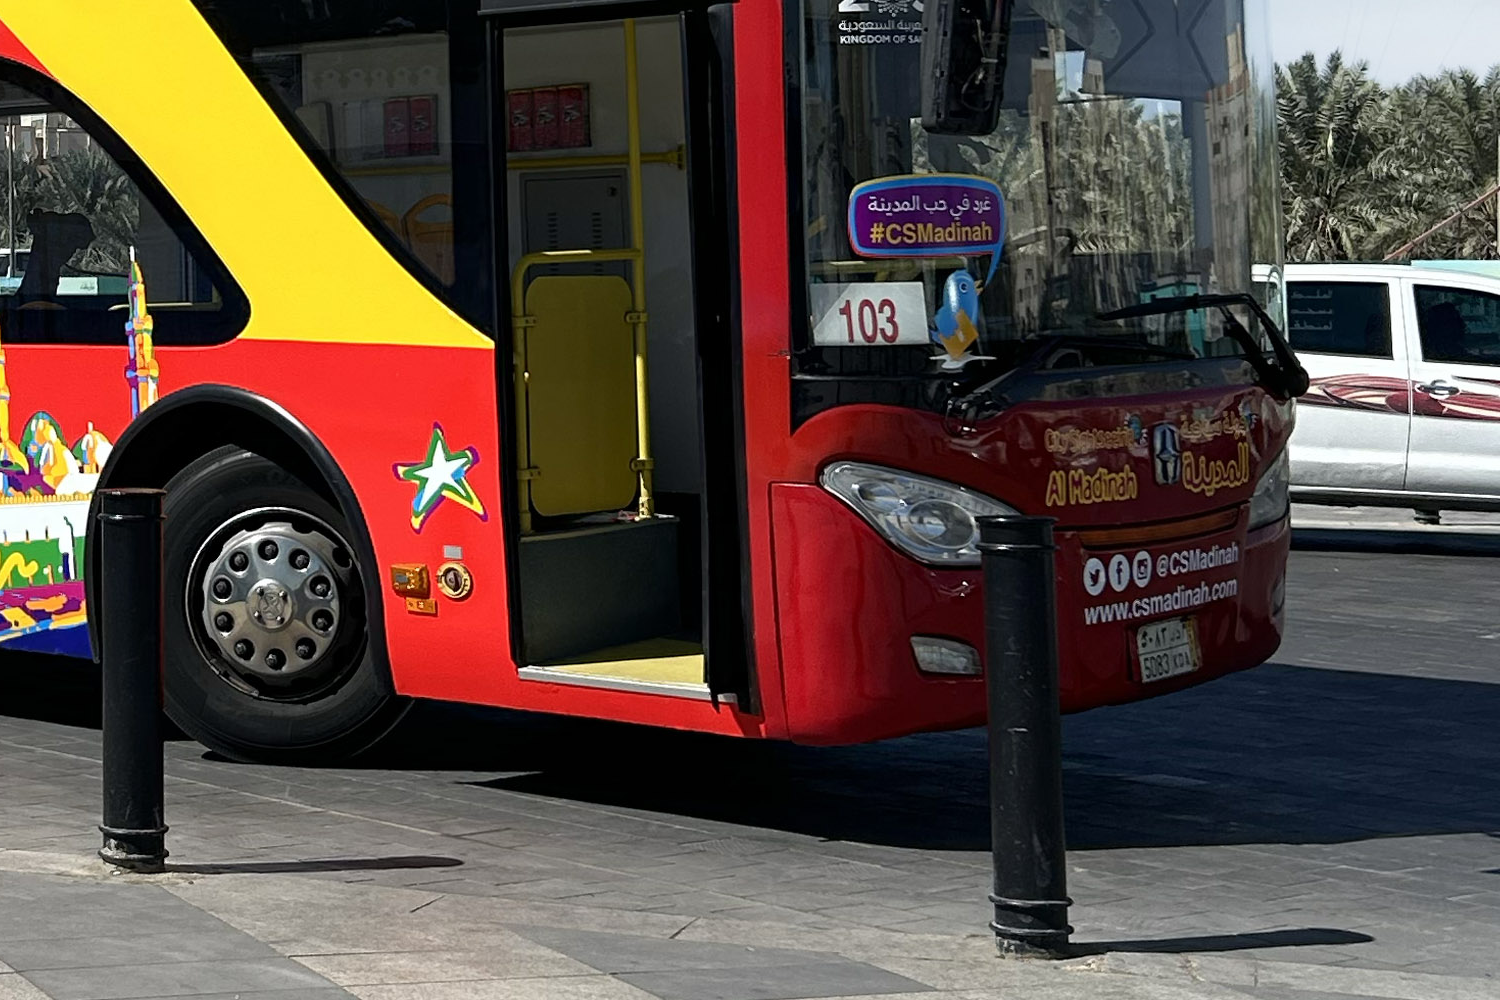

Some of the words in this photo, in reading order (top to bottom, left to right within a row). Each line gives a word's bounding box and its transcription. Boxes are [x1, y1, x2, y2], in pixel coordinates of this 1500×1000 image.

[839, 34, 891, 45] KINGDOM
[892, 34, 907, 44] OF
[867, 195, 920, 216] المدينة
[949, 193, 970, 219] في
[869, 221, 993, 245] #CSMadinah
[839, 298, 899, 344] 103
[1045, 470, 1066, 506] Al
[1069, 464, 1138, 505] Madinah
[1182, 442, 1250, 497] المدينة
[1156, 541, 1239, 578] @CSMadinah
[1084, 578, 1237, 625] www.csmadinah.com
[1143, 653, 1170, 679] 5083
